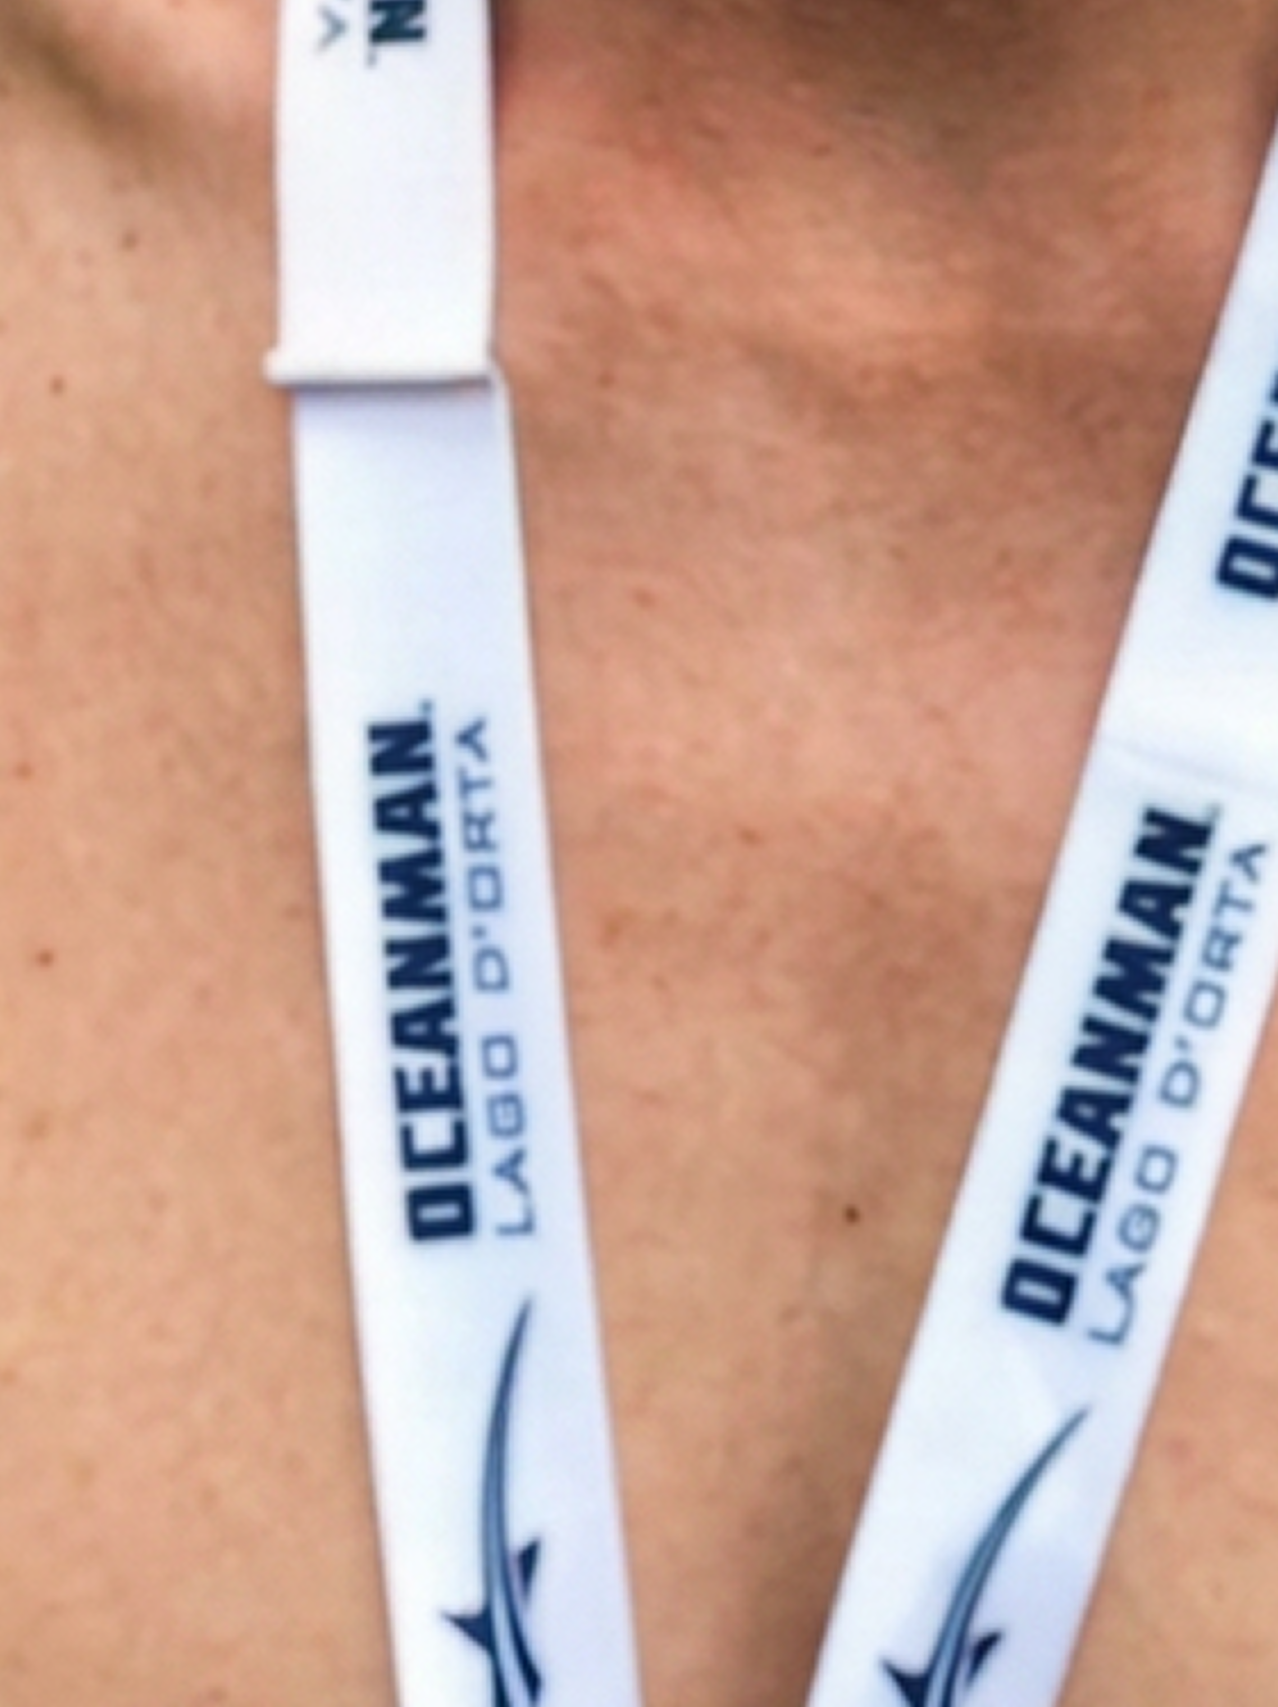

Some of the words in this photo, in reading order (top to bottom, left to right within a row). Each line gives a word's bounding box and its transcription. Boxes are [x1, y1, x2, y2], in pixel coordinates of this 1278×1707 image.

[366, 716, 478, 1243] OCEANMAN
[452, 716, 512, 995] D'ORTA
[1000, 806, 1213, 1327] OCEANMAN
[1085, 1143, 1179, 1348] LAGO
[1154, 841, 1269, 1111] D'ORTA
[479, 1032, 537, 1238] LAGO
